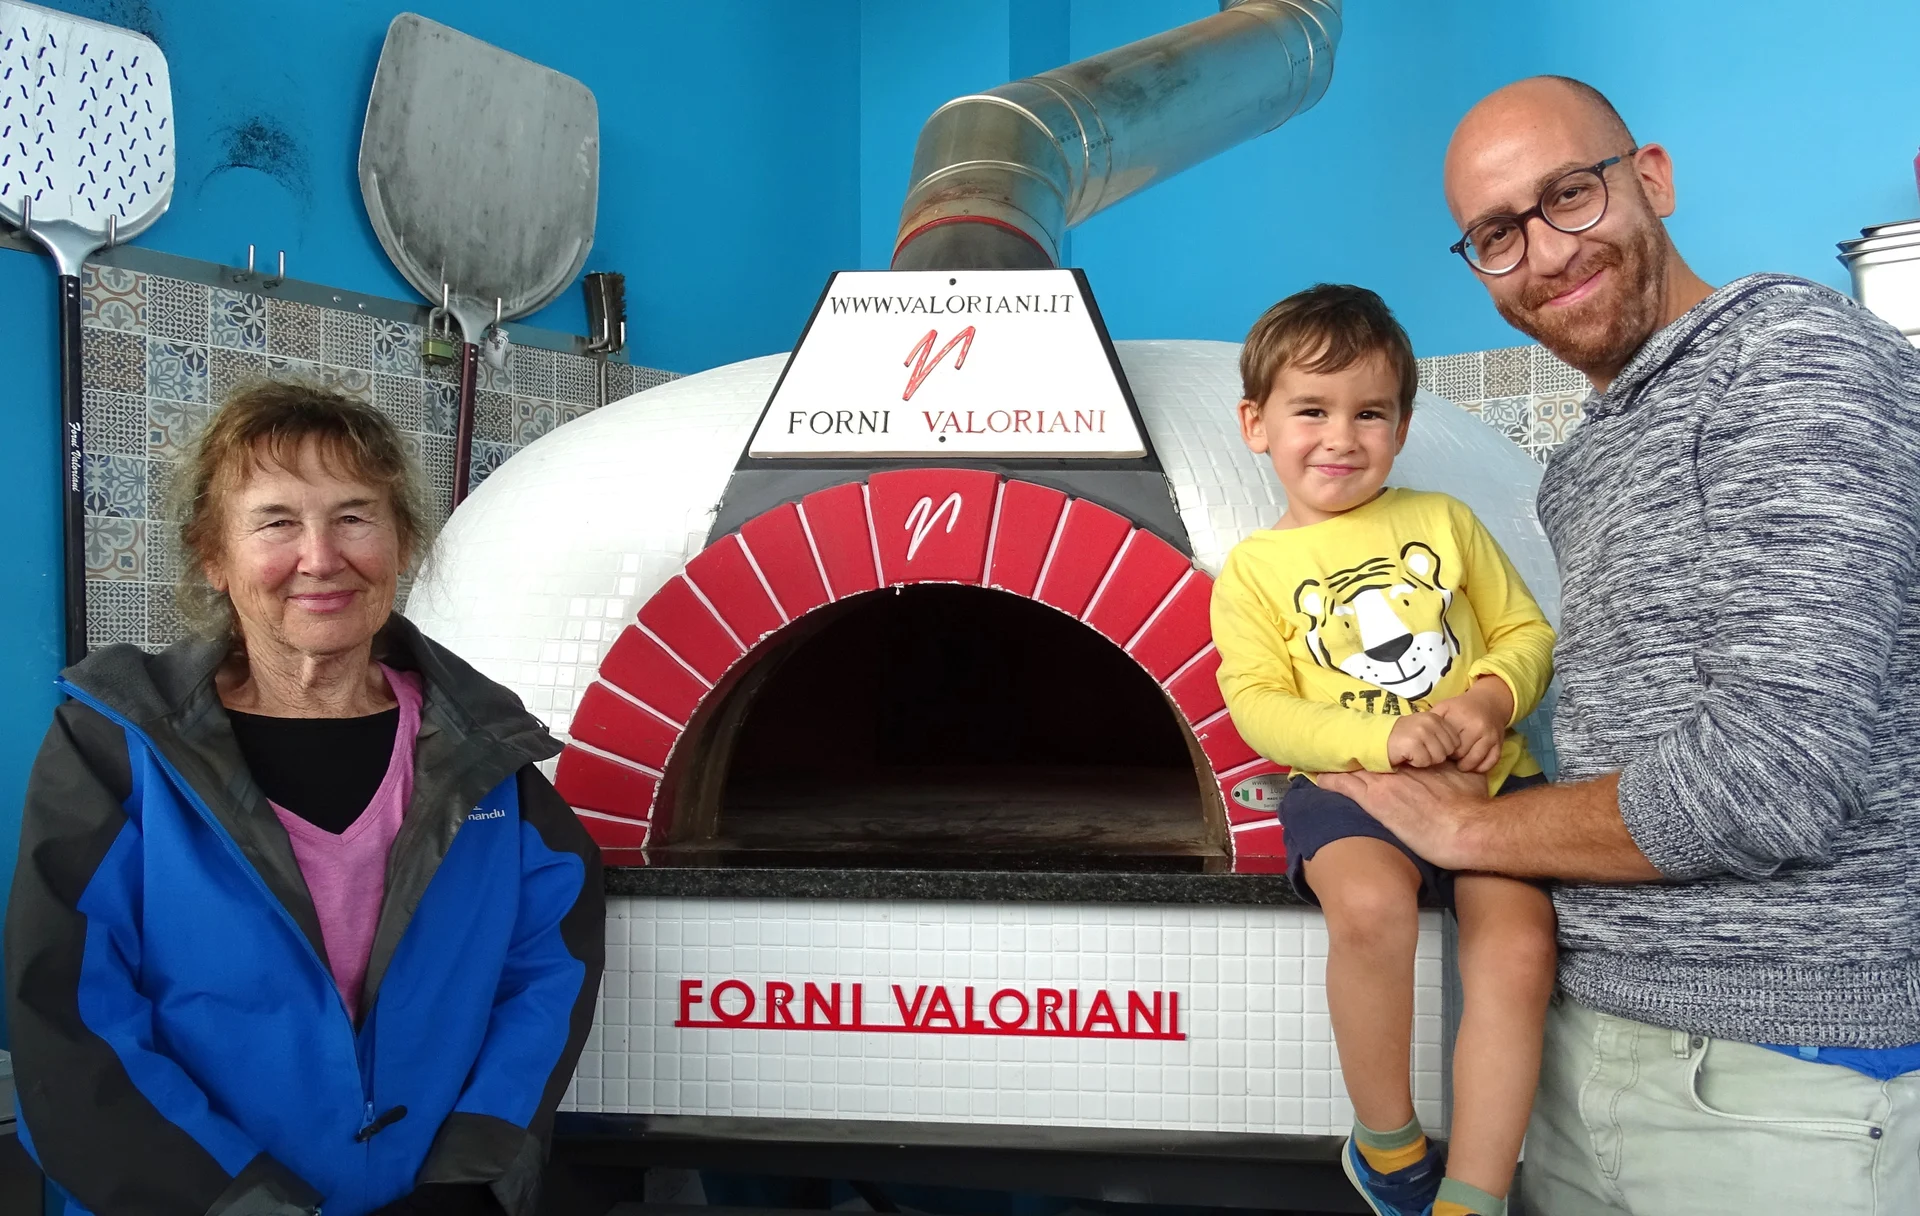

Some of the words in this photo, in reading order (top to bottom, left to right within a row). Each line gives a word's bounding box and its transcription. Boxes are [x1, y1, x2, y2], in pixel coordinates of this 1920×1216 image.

[830, 294, 1075, 315] WWW.VALORIANI.IT
[68, 421, 82, 448] Forni
[787, 410, 890, 435] FORNI
[922, 409, 1106, 434] VALORIANI
[70, 449, 82, 493] Valoriani
[679, 979, 862, 1028] FORNI
[891, 984, 1181, 1037] VALORIANI
